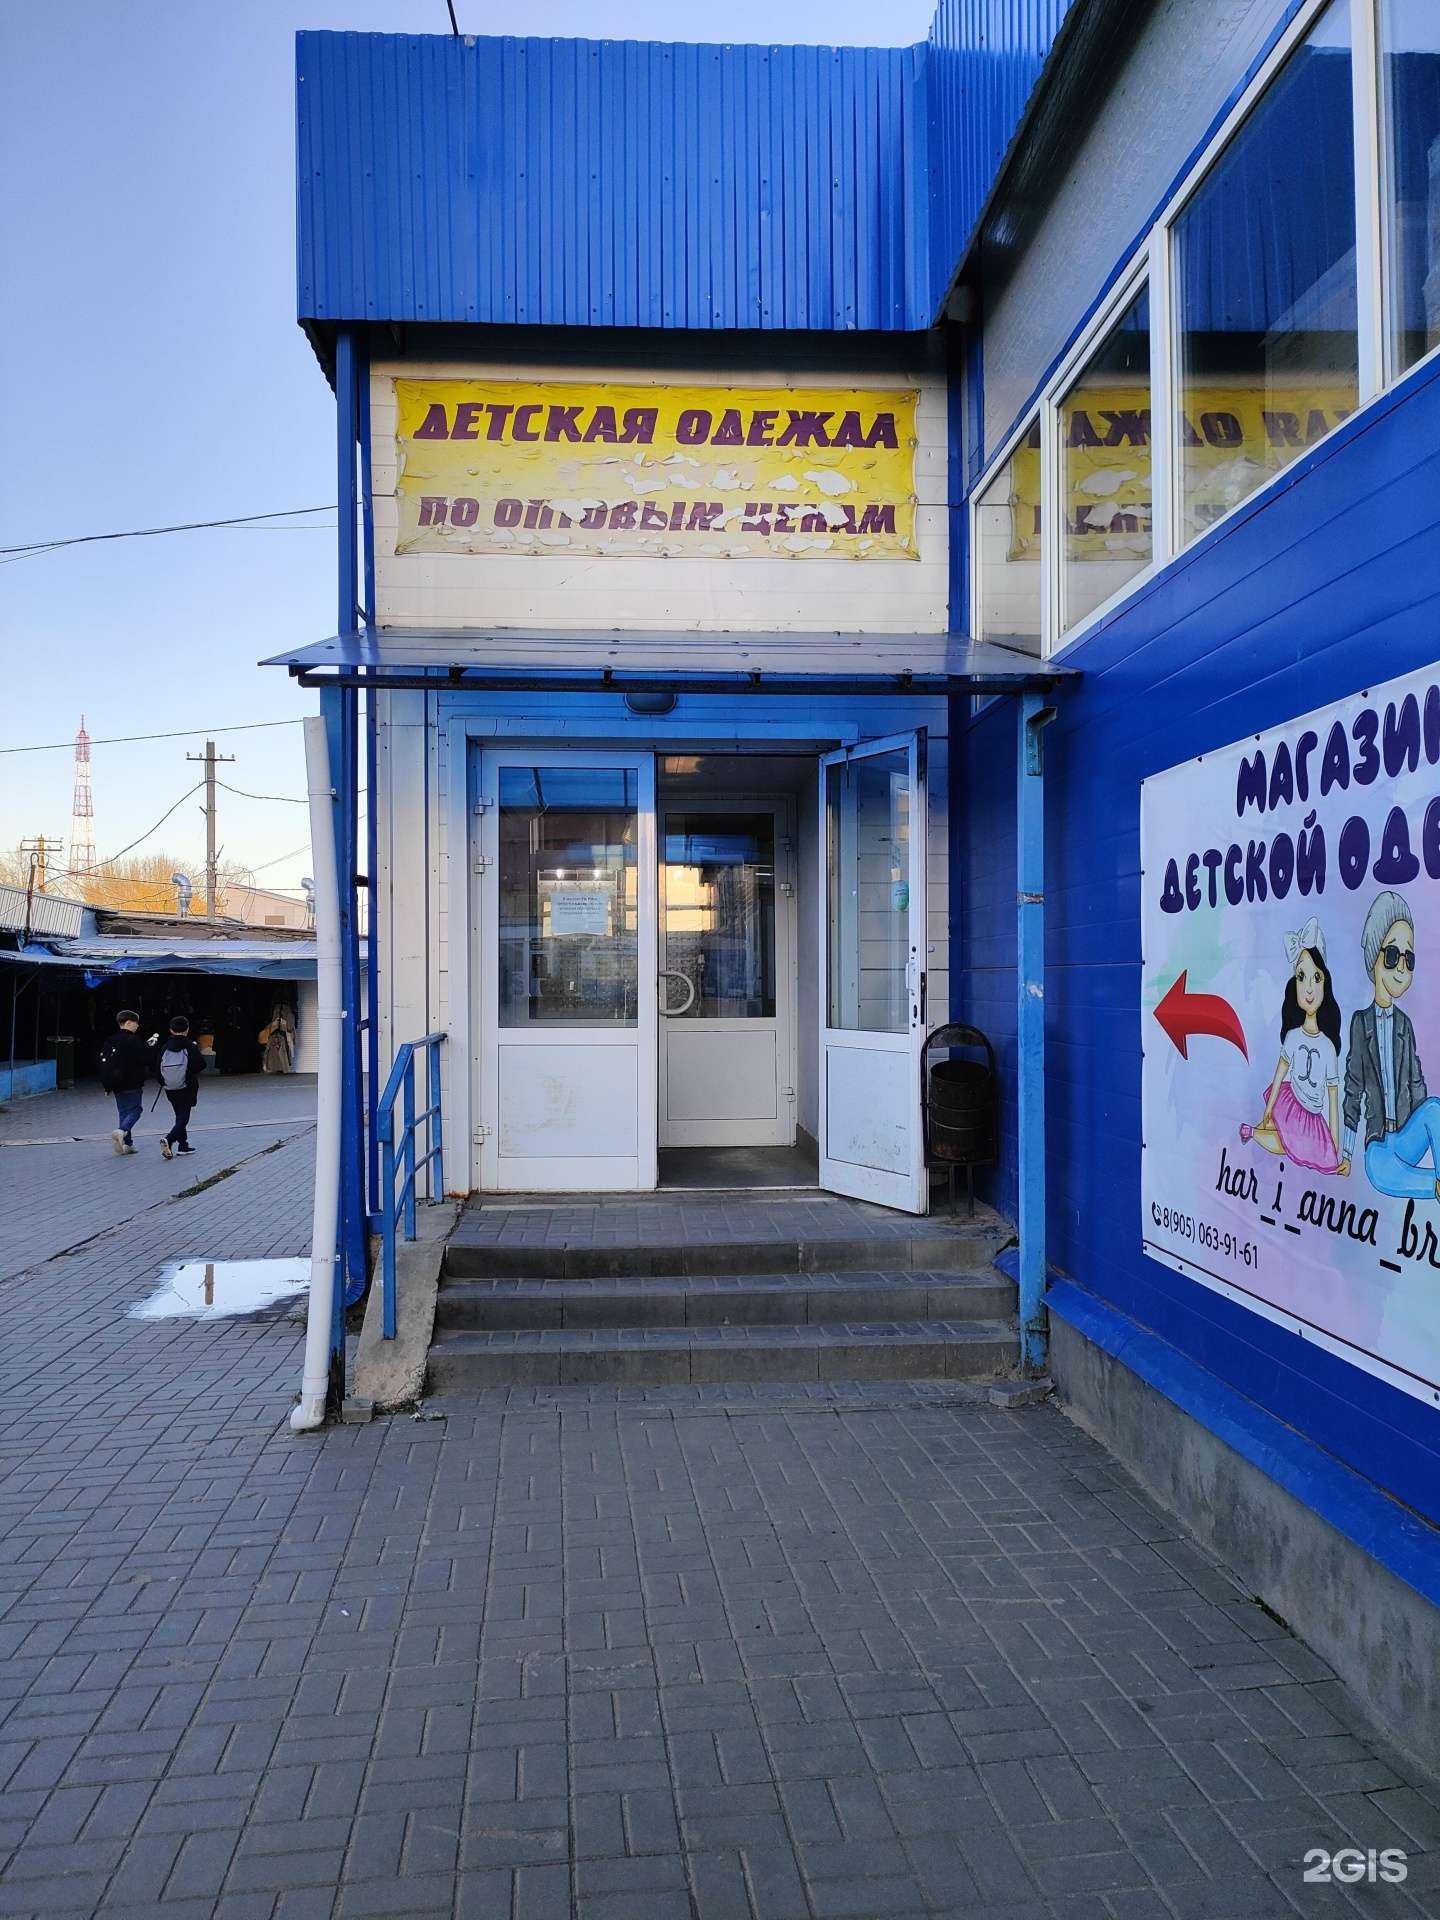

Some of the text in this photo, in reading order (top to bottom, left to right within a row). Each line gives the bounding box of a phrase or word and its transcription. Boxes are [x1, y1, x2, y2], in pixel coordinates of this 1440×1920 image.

[413, 403, 899, 448] ДЕТСКАЯ ОДЕЖДА
[417, 497, 480, 527] ПО
[494, 498, 727, 533] ОПОВЫМ
[1160, 809, 1327, 914] ДЕТСКОЙ
[1163, 1207, 1258, 1270] 8(905) 063-91-61
